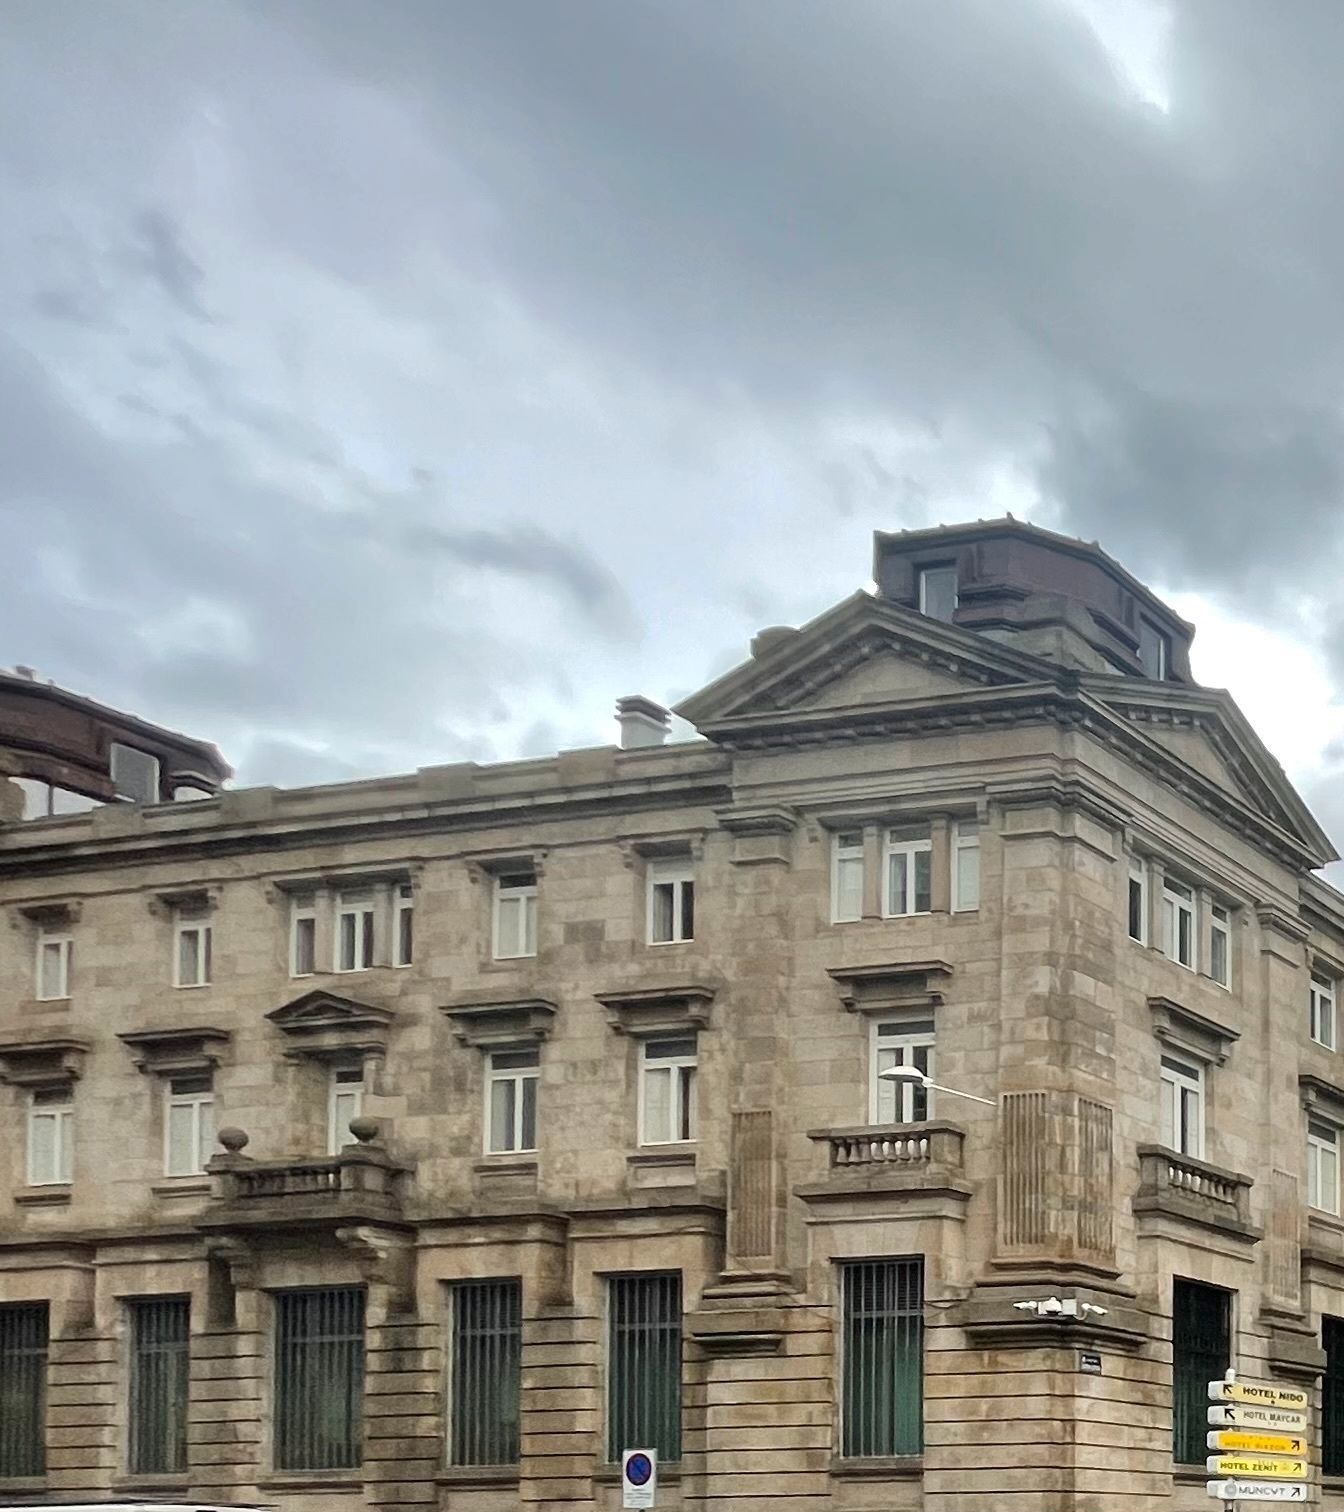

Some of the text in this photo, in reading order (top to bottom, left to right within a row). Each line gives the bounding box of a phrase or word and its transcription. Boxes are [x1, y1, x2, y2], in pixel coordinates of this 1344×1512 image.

[1243, 1387, 1304, 1403] HOTEL NIDO
[1243, 1411, 1267, 1421] HOTEL
[1220, 1462, 1278, 1472] HOTEL ZENIT
